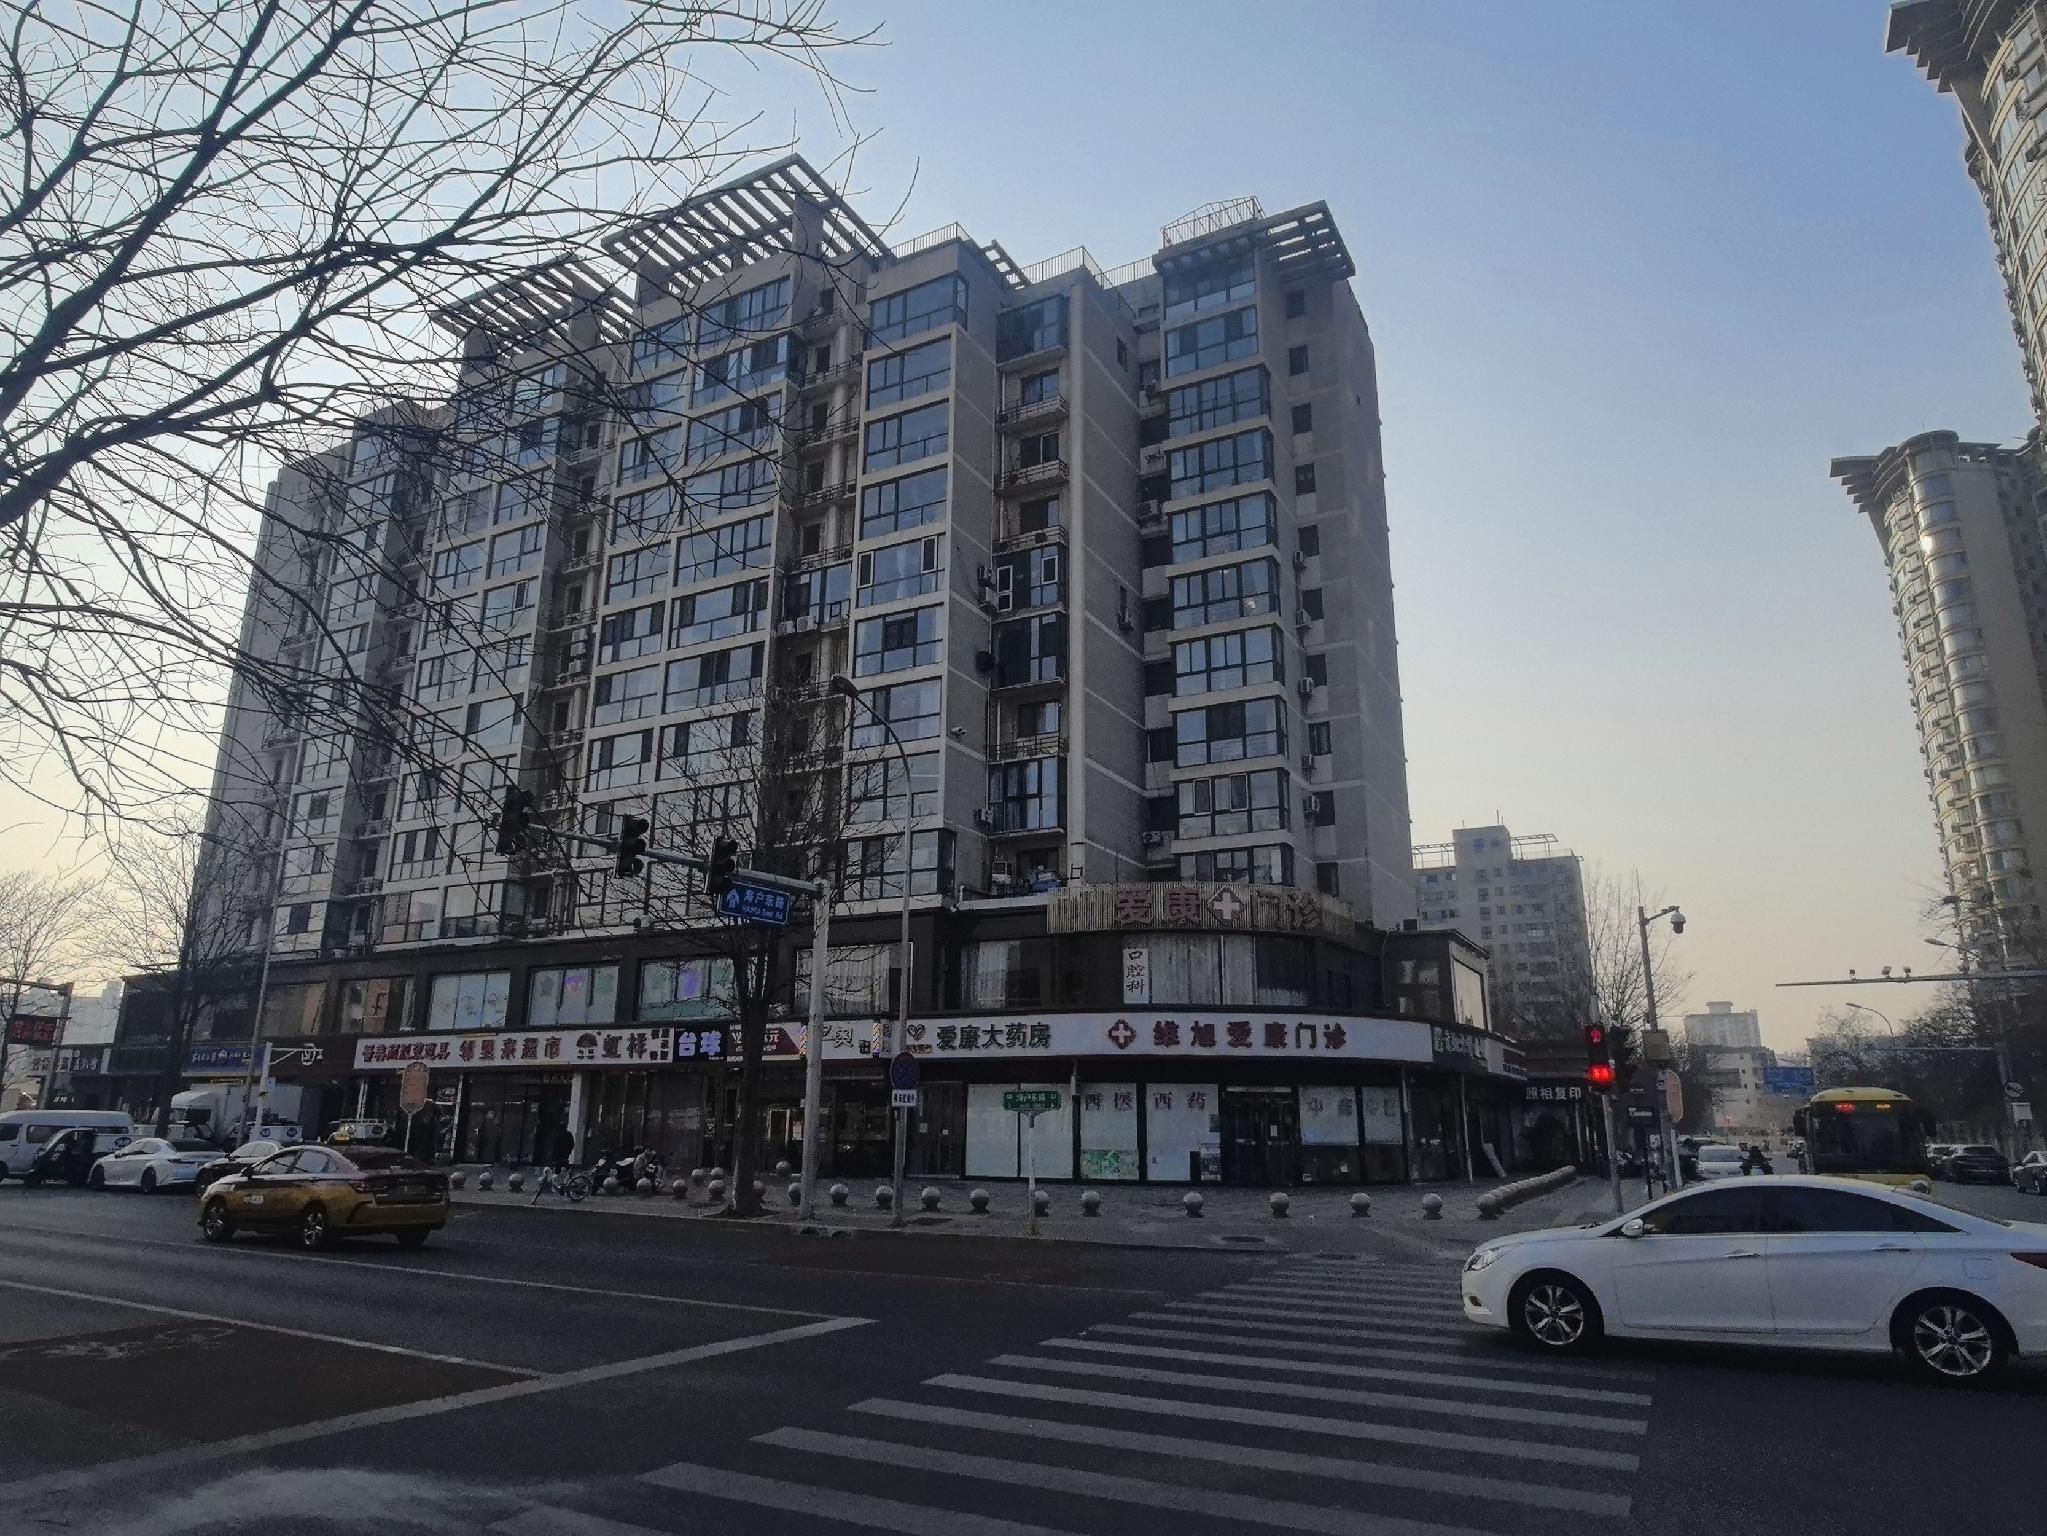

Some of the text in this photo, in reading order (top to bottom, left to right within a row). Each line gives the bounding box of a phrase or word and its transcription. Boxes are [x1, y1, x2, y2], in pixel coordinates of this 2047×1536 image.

[1115, 887, 1323, 930] 爱康 门诊
[1126, 950, 1145, 994] 口腔科
[678, 1029, 722, 1057] 台球
[935, 1021, 1053, 1051] 爱康大药房
[1525, 1086, 1583, 1101] 照相复印
